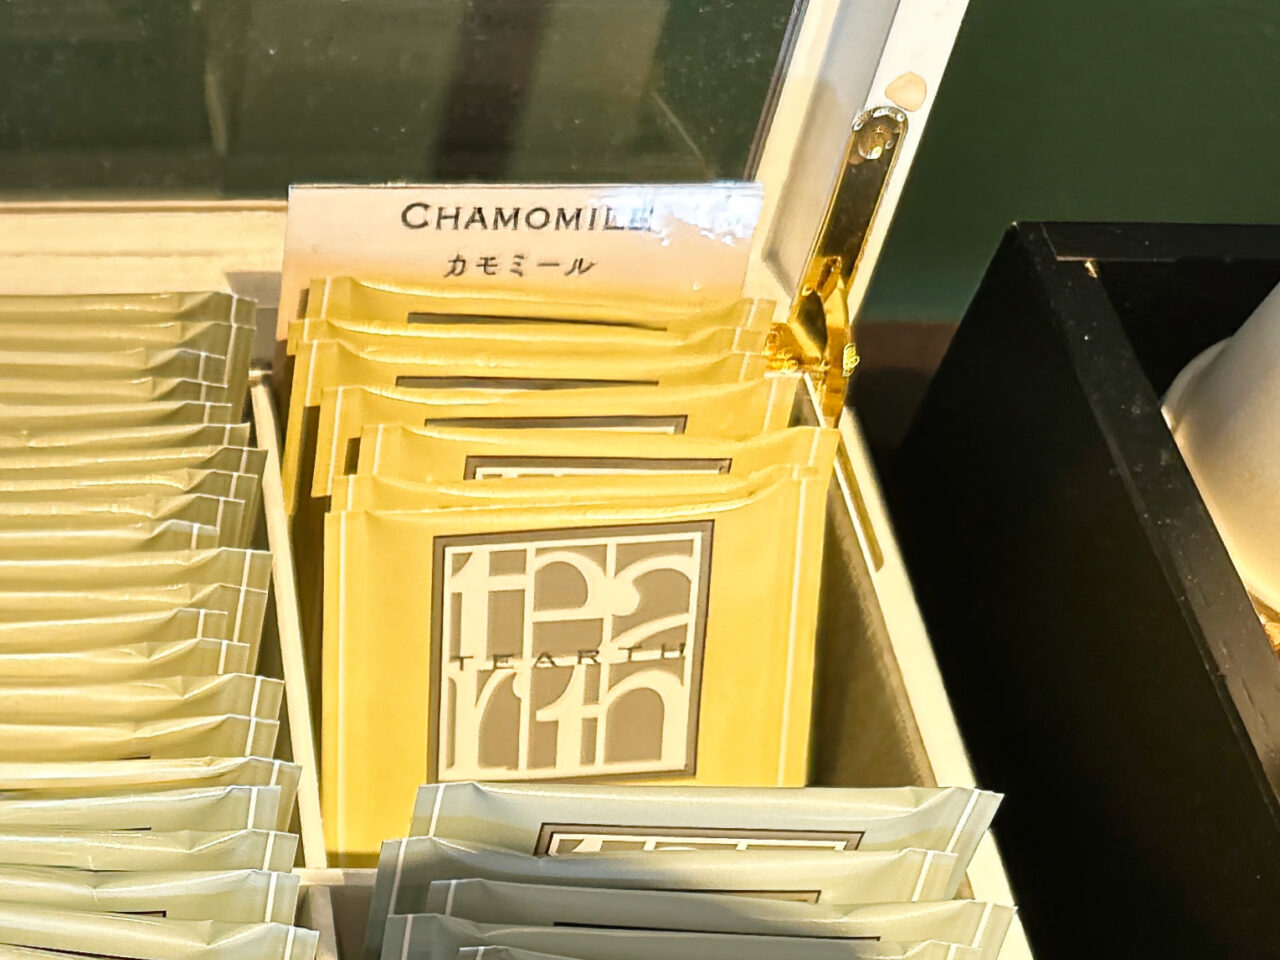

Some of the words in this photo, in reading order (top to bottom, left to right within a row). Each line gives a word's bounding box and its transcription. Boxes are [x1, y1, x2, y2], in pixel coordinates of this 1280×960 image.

[444, 253, 596, 278] カモミール
[451, 643, 685, 671] TEARTH
